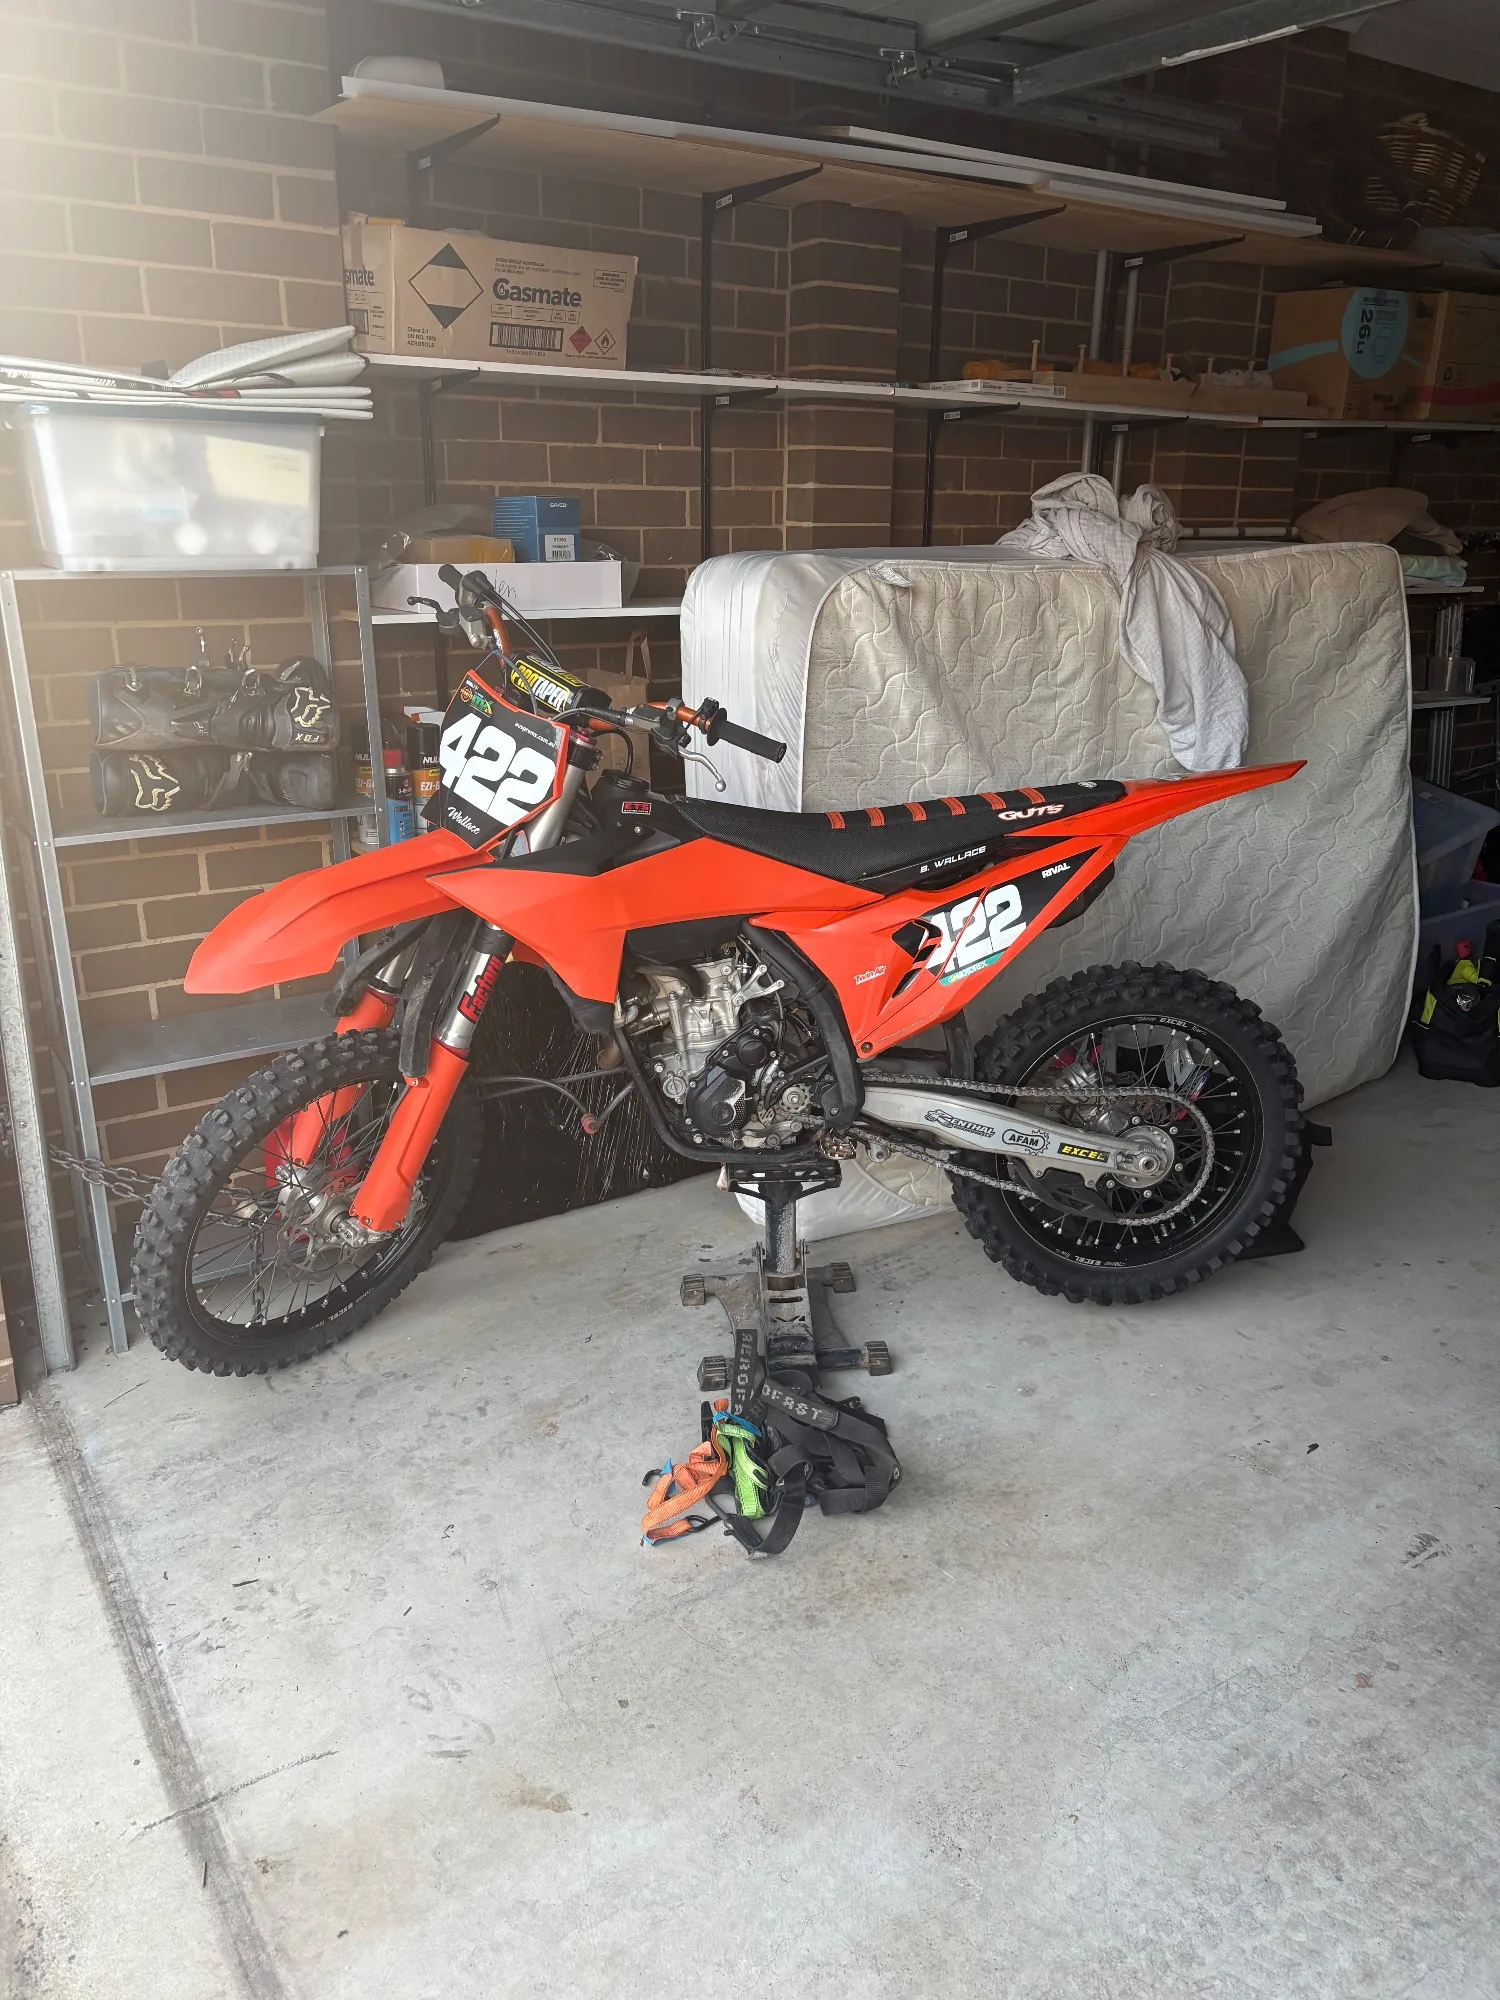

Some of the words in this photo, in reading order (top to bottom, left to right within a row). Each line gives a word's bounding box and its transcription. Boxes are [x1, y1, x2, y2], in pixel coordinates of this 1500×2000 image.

[345, 268, 375, 287] smate
[492, 277, 582, 307] Gasmate
[355, 753, 372, 761] NUL
[422, 756, 440, 764] NUL
[439, 712, 556, 827] 422
[447, 806, 480, 835] Wallace
[998, 803, 1065, 821] GUTS
[934, 845, 987, 868] WALLACE
[1041, 862, 1071, 879] RIVAL
[956, 960, 988, 980] MOTOREX
[1008, 1134, 1040, 1147] AFAM
[1061, 1145, 1105, 1161] EXCEL
